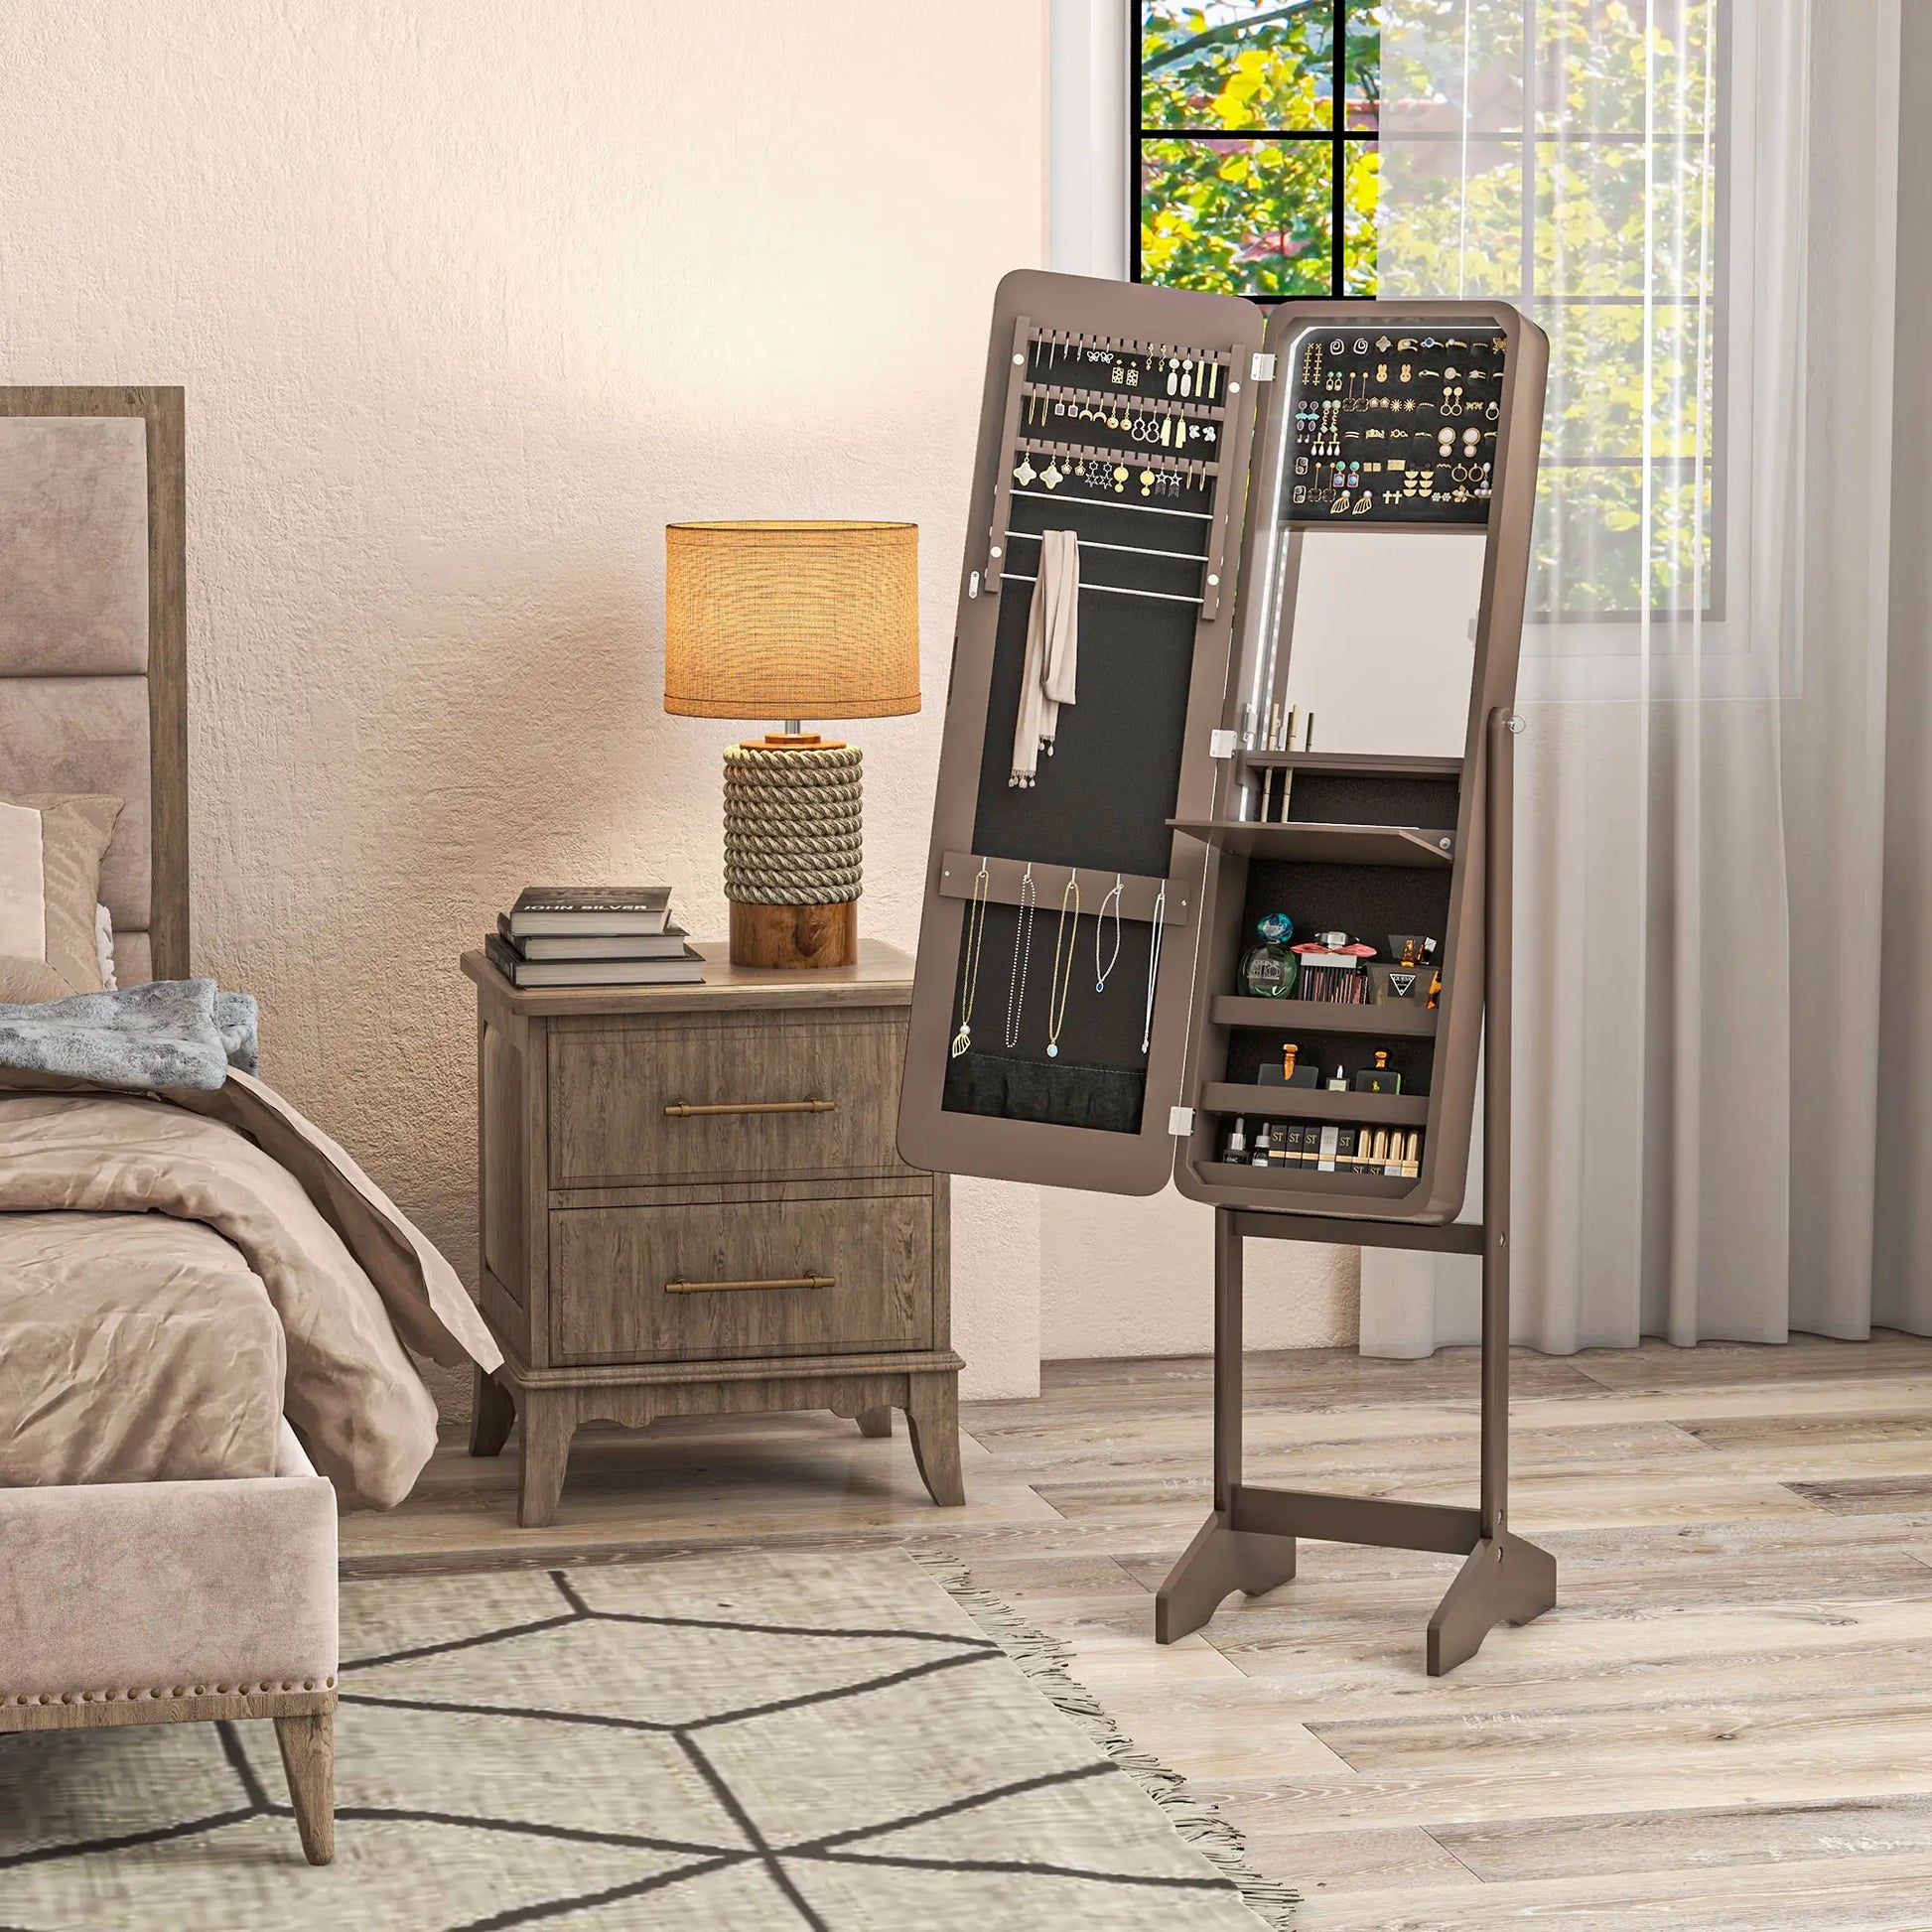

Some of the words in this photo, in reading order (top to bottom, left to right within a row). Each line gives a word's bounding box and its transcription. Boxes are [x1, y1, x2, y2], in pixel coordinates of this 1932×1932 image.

[1273, 1132, 1283, 1142] ST
[1289, 1133, 1301, 1143] ST
[1306, 1134, 1316, 1144] ST
[1339, 1137, 1351, 1147] ST
